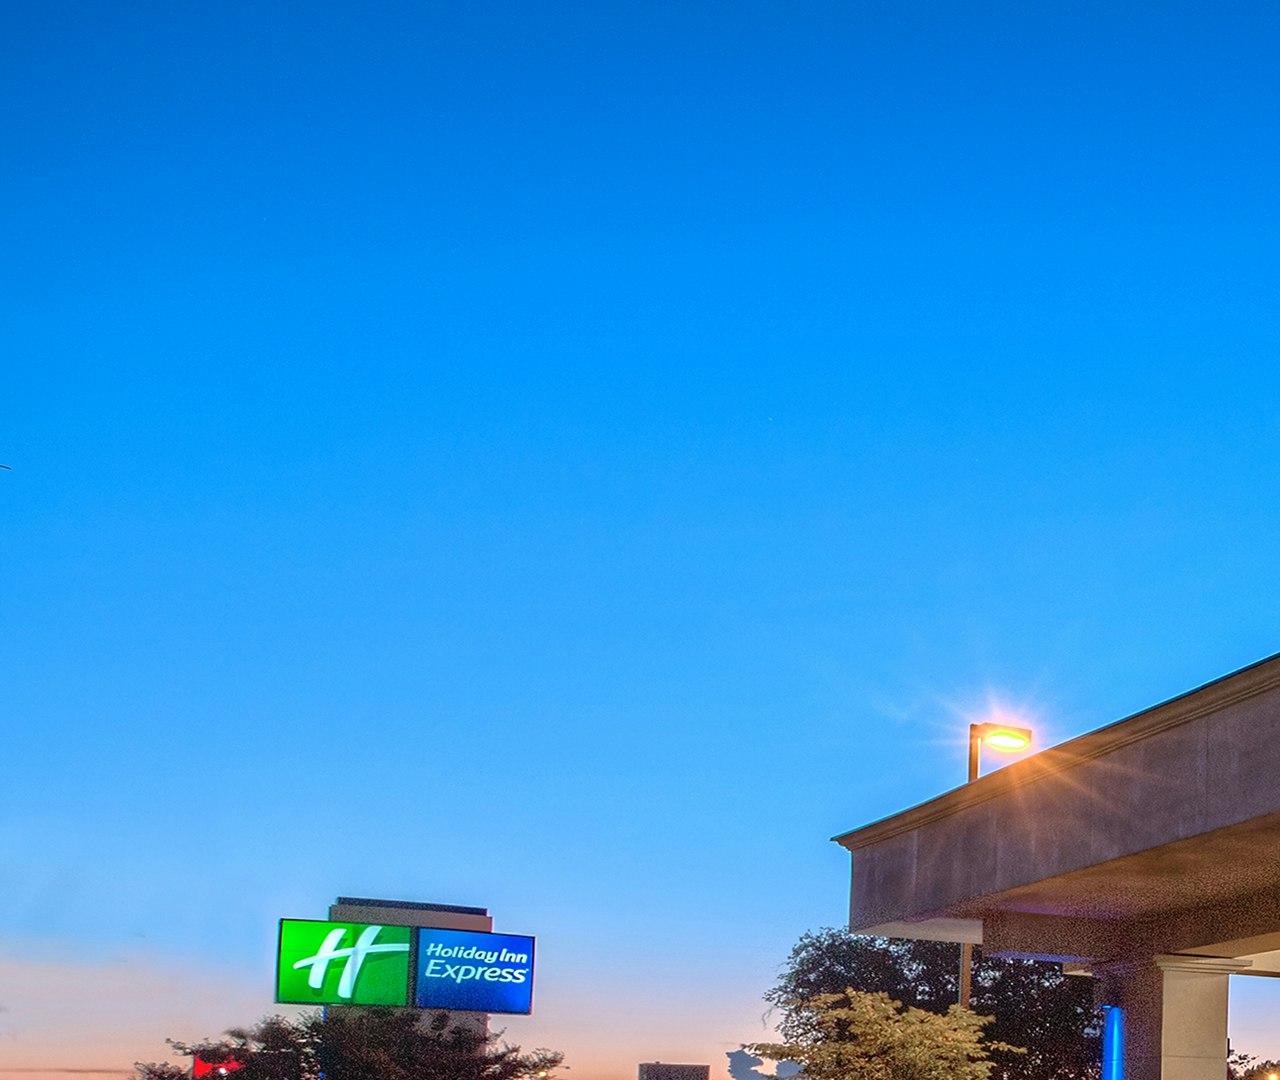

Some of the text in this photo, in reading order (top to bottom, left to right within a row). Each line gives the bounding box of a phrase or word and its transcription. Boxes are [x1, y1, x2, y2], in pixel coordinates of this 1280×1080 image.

[426, 943, 528, 964] Holiday Inn
[425, 959, 527, 984] Express
